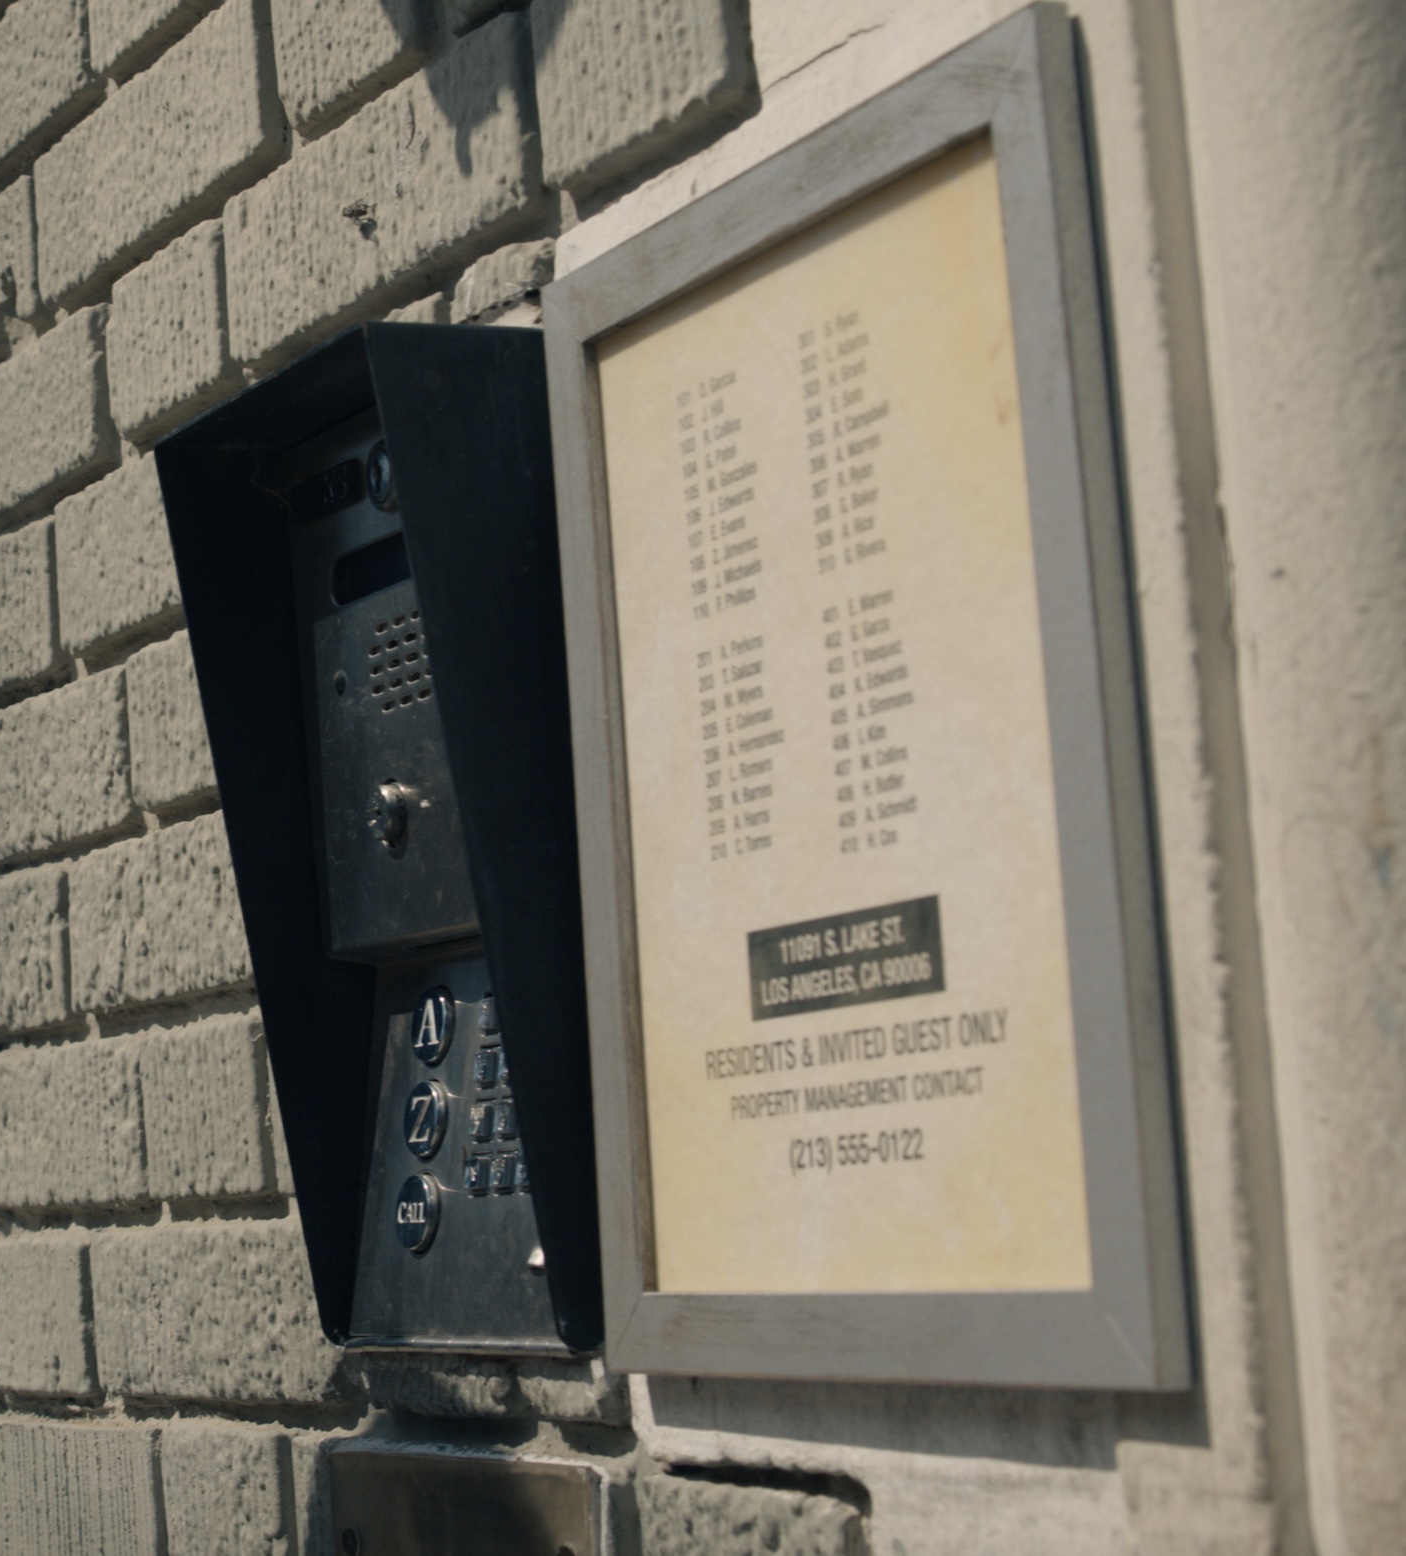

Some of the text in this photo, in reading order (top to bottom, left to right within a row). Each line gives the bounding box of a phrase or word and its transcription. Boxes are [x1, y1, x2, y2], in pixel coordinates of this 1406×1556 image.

[780, 915, 905, 964] 11091 S. LAKE ST.
[760, 951, 931, 1006] LOS ANGELES, CA 90006
[414, 999, 439, 1047] A
[705, 1008, 1009, 1080] RESIDENTS & INVITED GUEST ONLY
[730, 1066, 984, 1120] PROPERTY MANAGEMENT CONTACT
[408, 1095, 432, 1143] Z
[789, 1128, 924, 1175] (213) 555-0122
[397, 1202, 426, 1224] CALL
